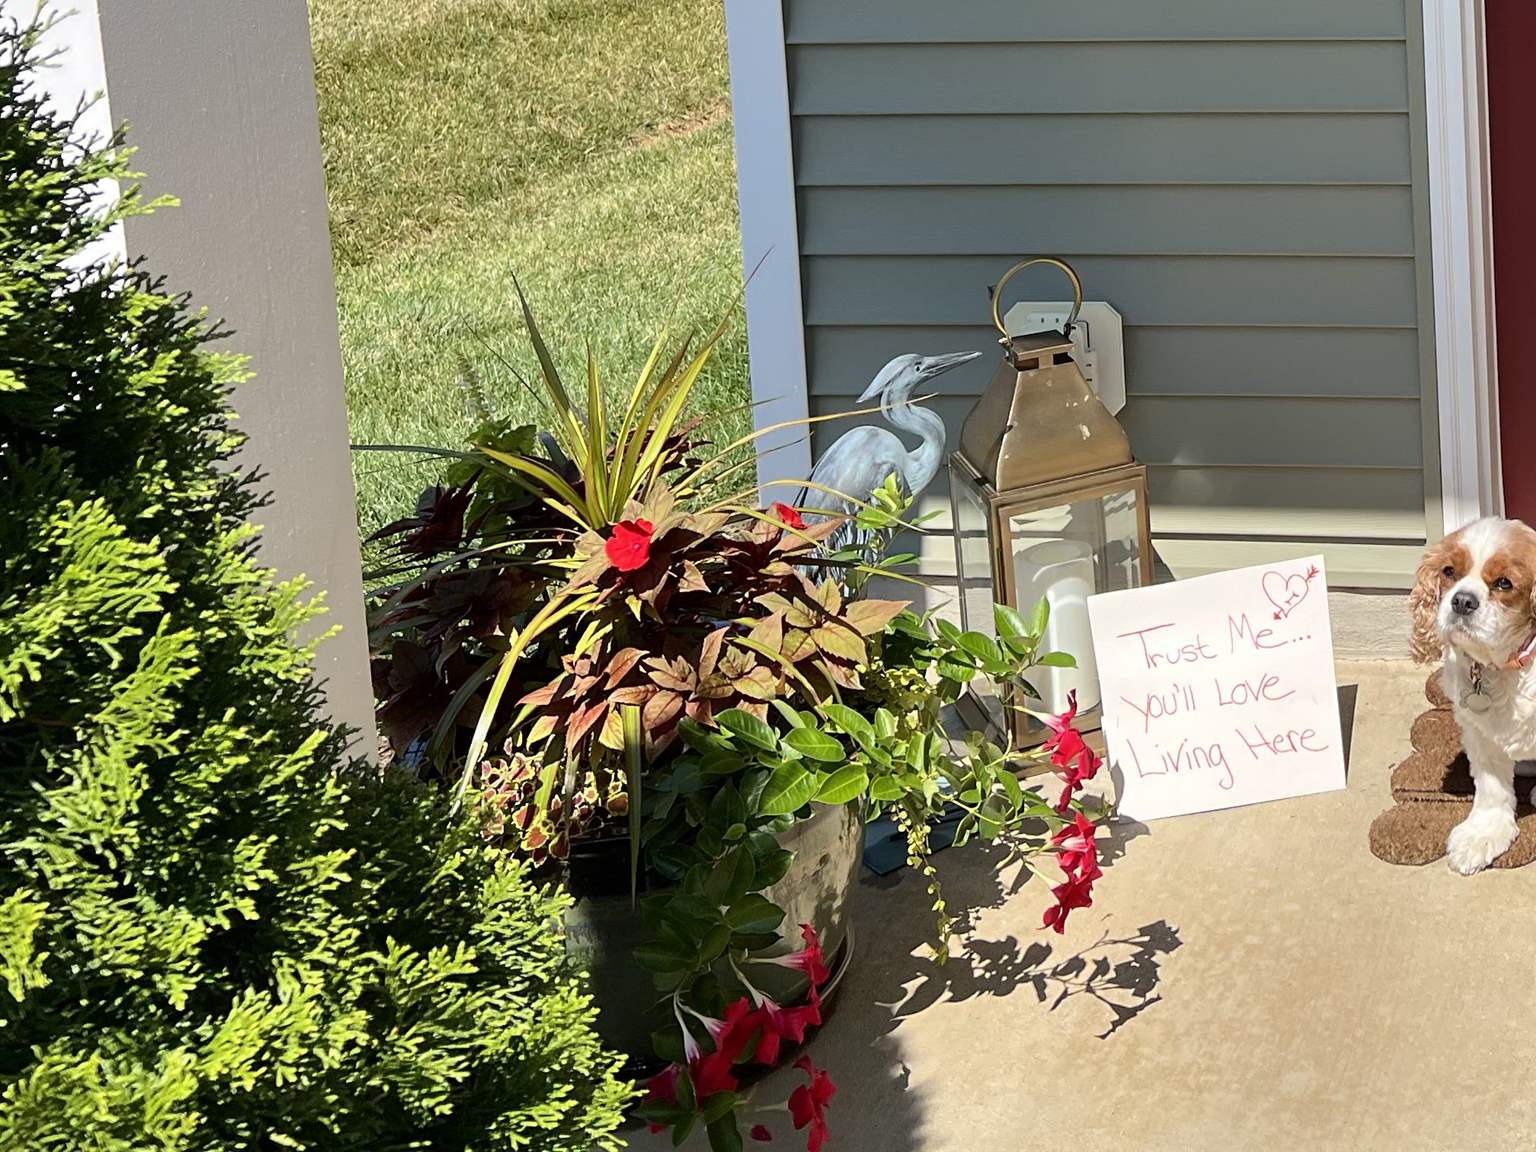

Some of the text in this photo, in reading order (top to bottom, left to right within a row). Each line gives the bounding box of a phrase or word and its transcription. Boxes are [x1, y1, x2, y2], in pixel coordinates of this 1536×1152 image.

[1116, 612, 1312, 669] Trust Me...
[1215, 672, 1296, 706] Love
[1126, 724, 1329, 790] Living Here
